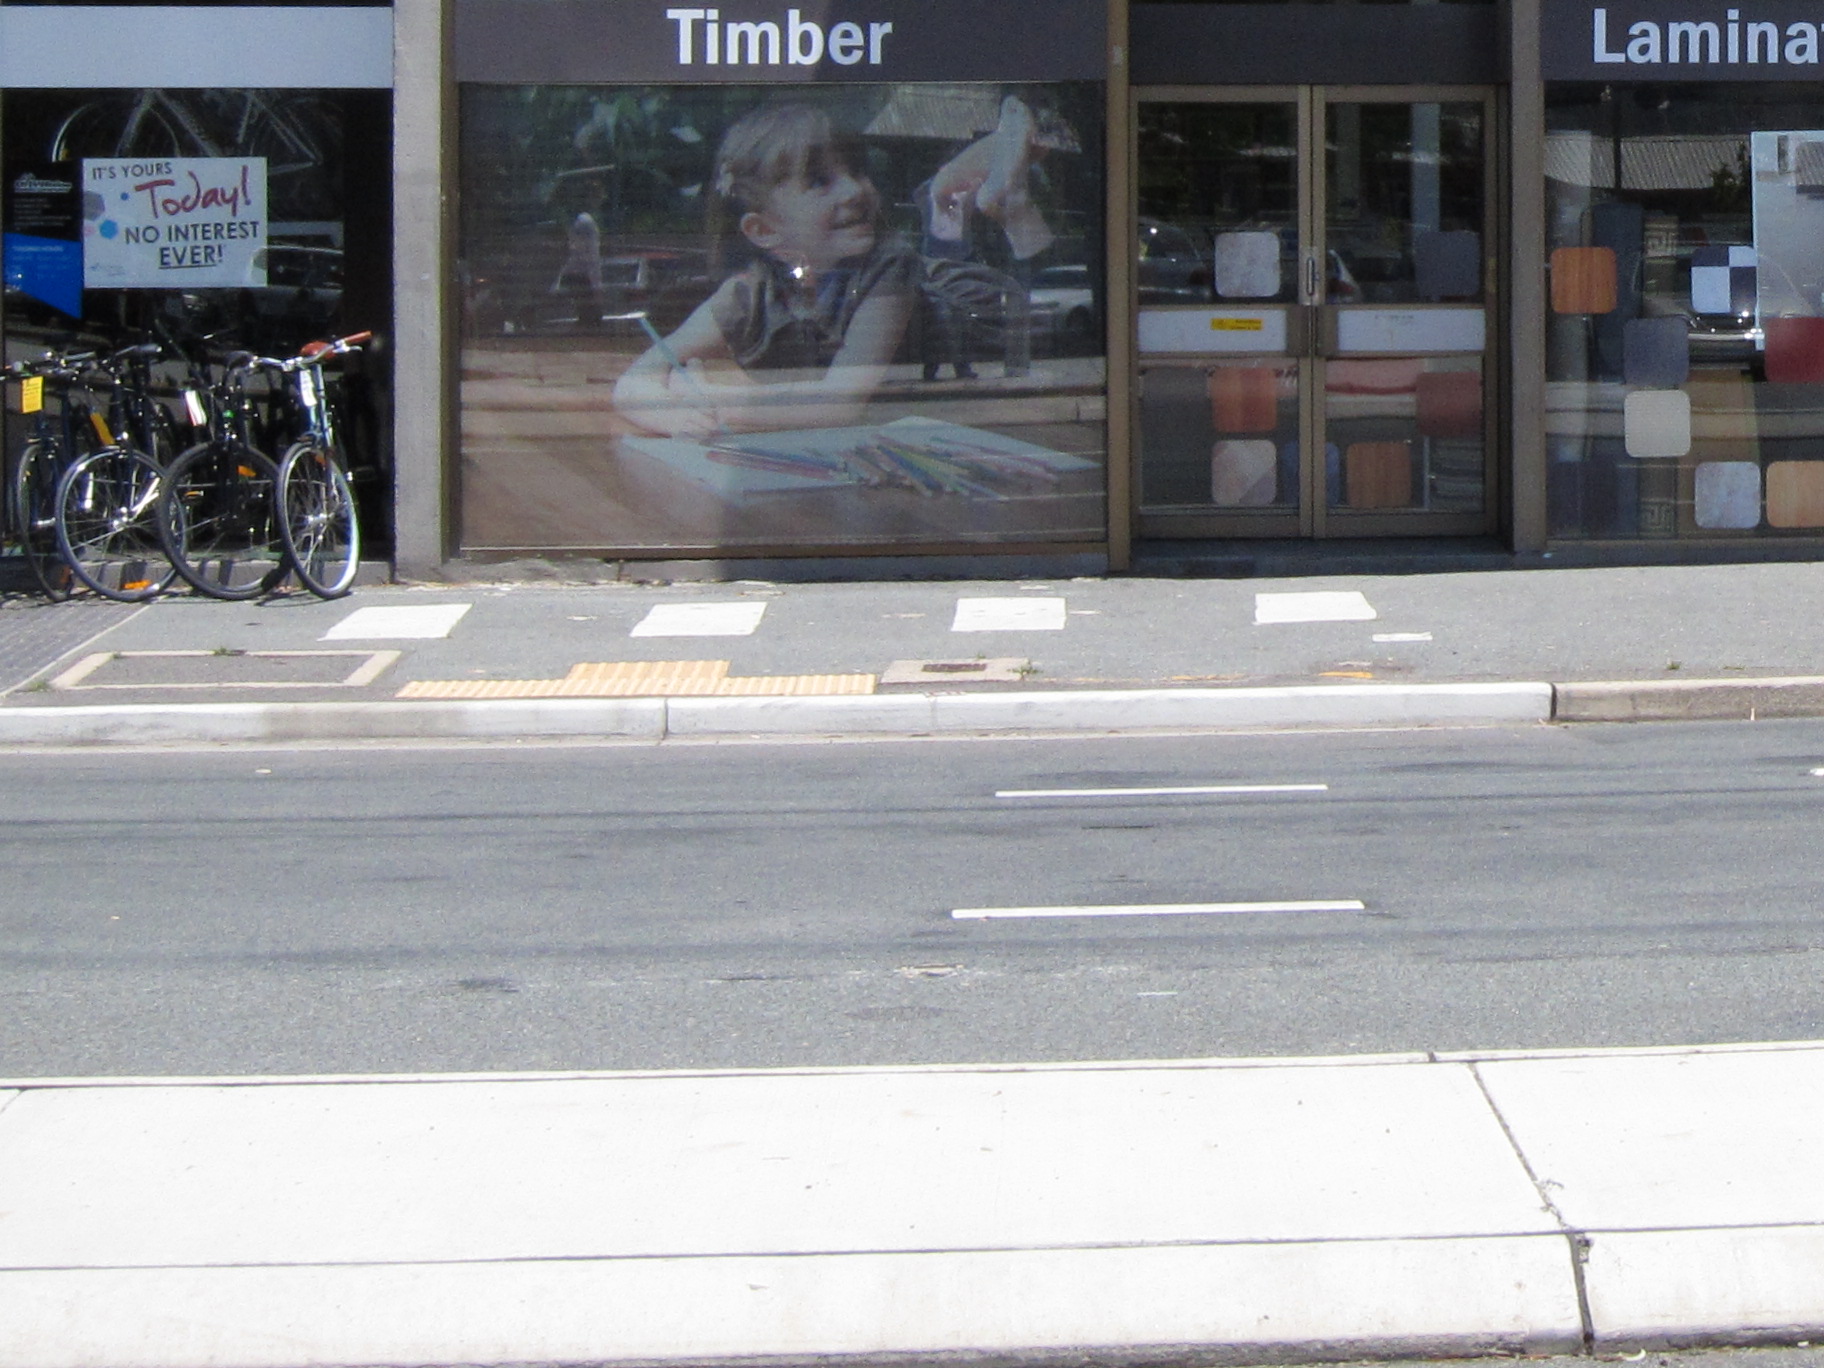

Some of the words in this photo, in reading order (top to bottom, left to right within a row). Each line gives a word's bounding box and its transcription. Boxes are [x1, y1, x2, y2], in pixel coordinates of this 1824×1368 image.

[666, 8, 892, 66] Timber
[92, 166, 117, 181] IT'S
[122, 162, 173, 179] YOURS
[134, 164, 253, 220] Today!
[125, 225, 160, 245] NO
[168, 221, 260, 243] INTEREST
[159, 244, 224, 267] EVER!
